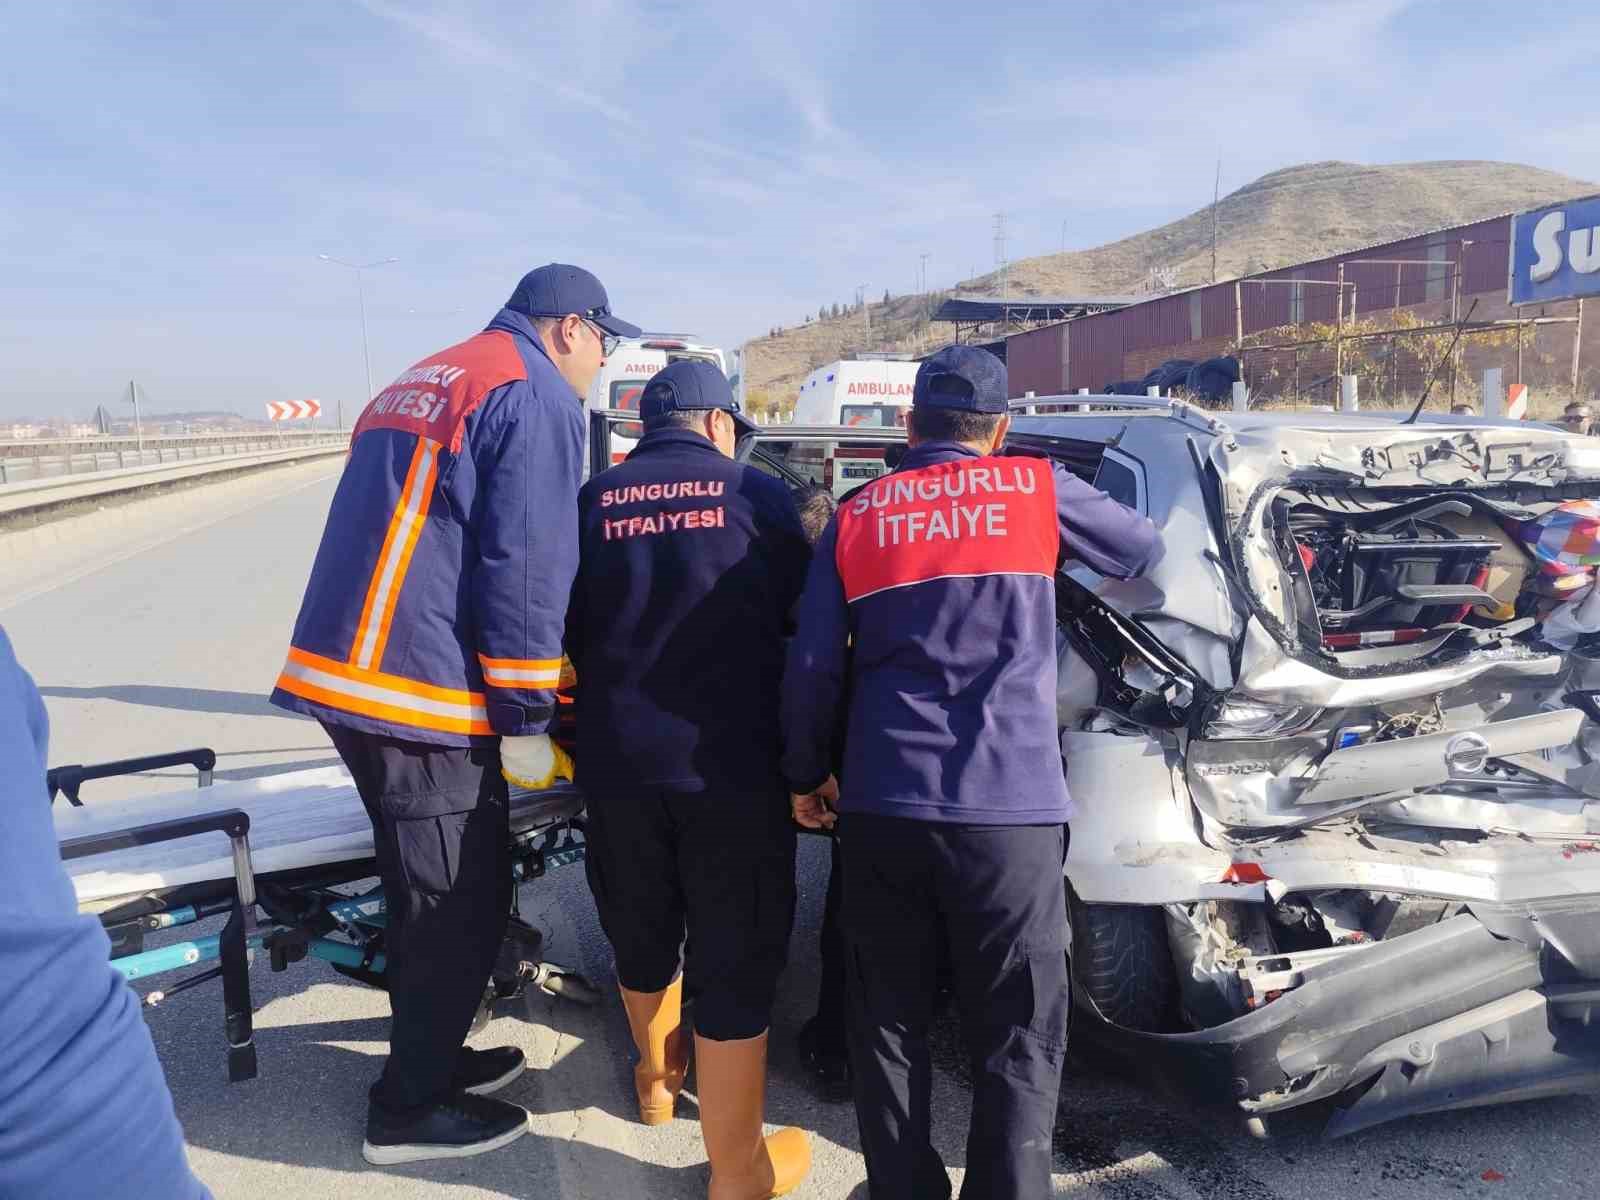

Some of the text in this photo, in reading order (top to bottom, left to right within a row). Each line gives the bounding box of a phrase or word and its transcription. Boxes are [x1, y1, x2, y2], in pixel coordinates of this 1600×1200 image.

[1530, 211, 1600, 281] Su
[624, 363, 665, 374] AMBU
[848, 382, 914, 395] AMBULAN
[602, 481, 724, 507] SUNGURLU
[852, 466, 1036, 515] SUNGURLU
[605, 507, 725, 540] İTFAİYESİ
[878, 500, 1008, 547] İTFAİYE
